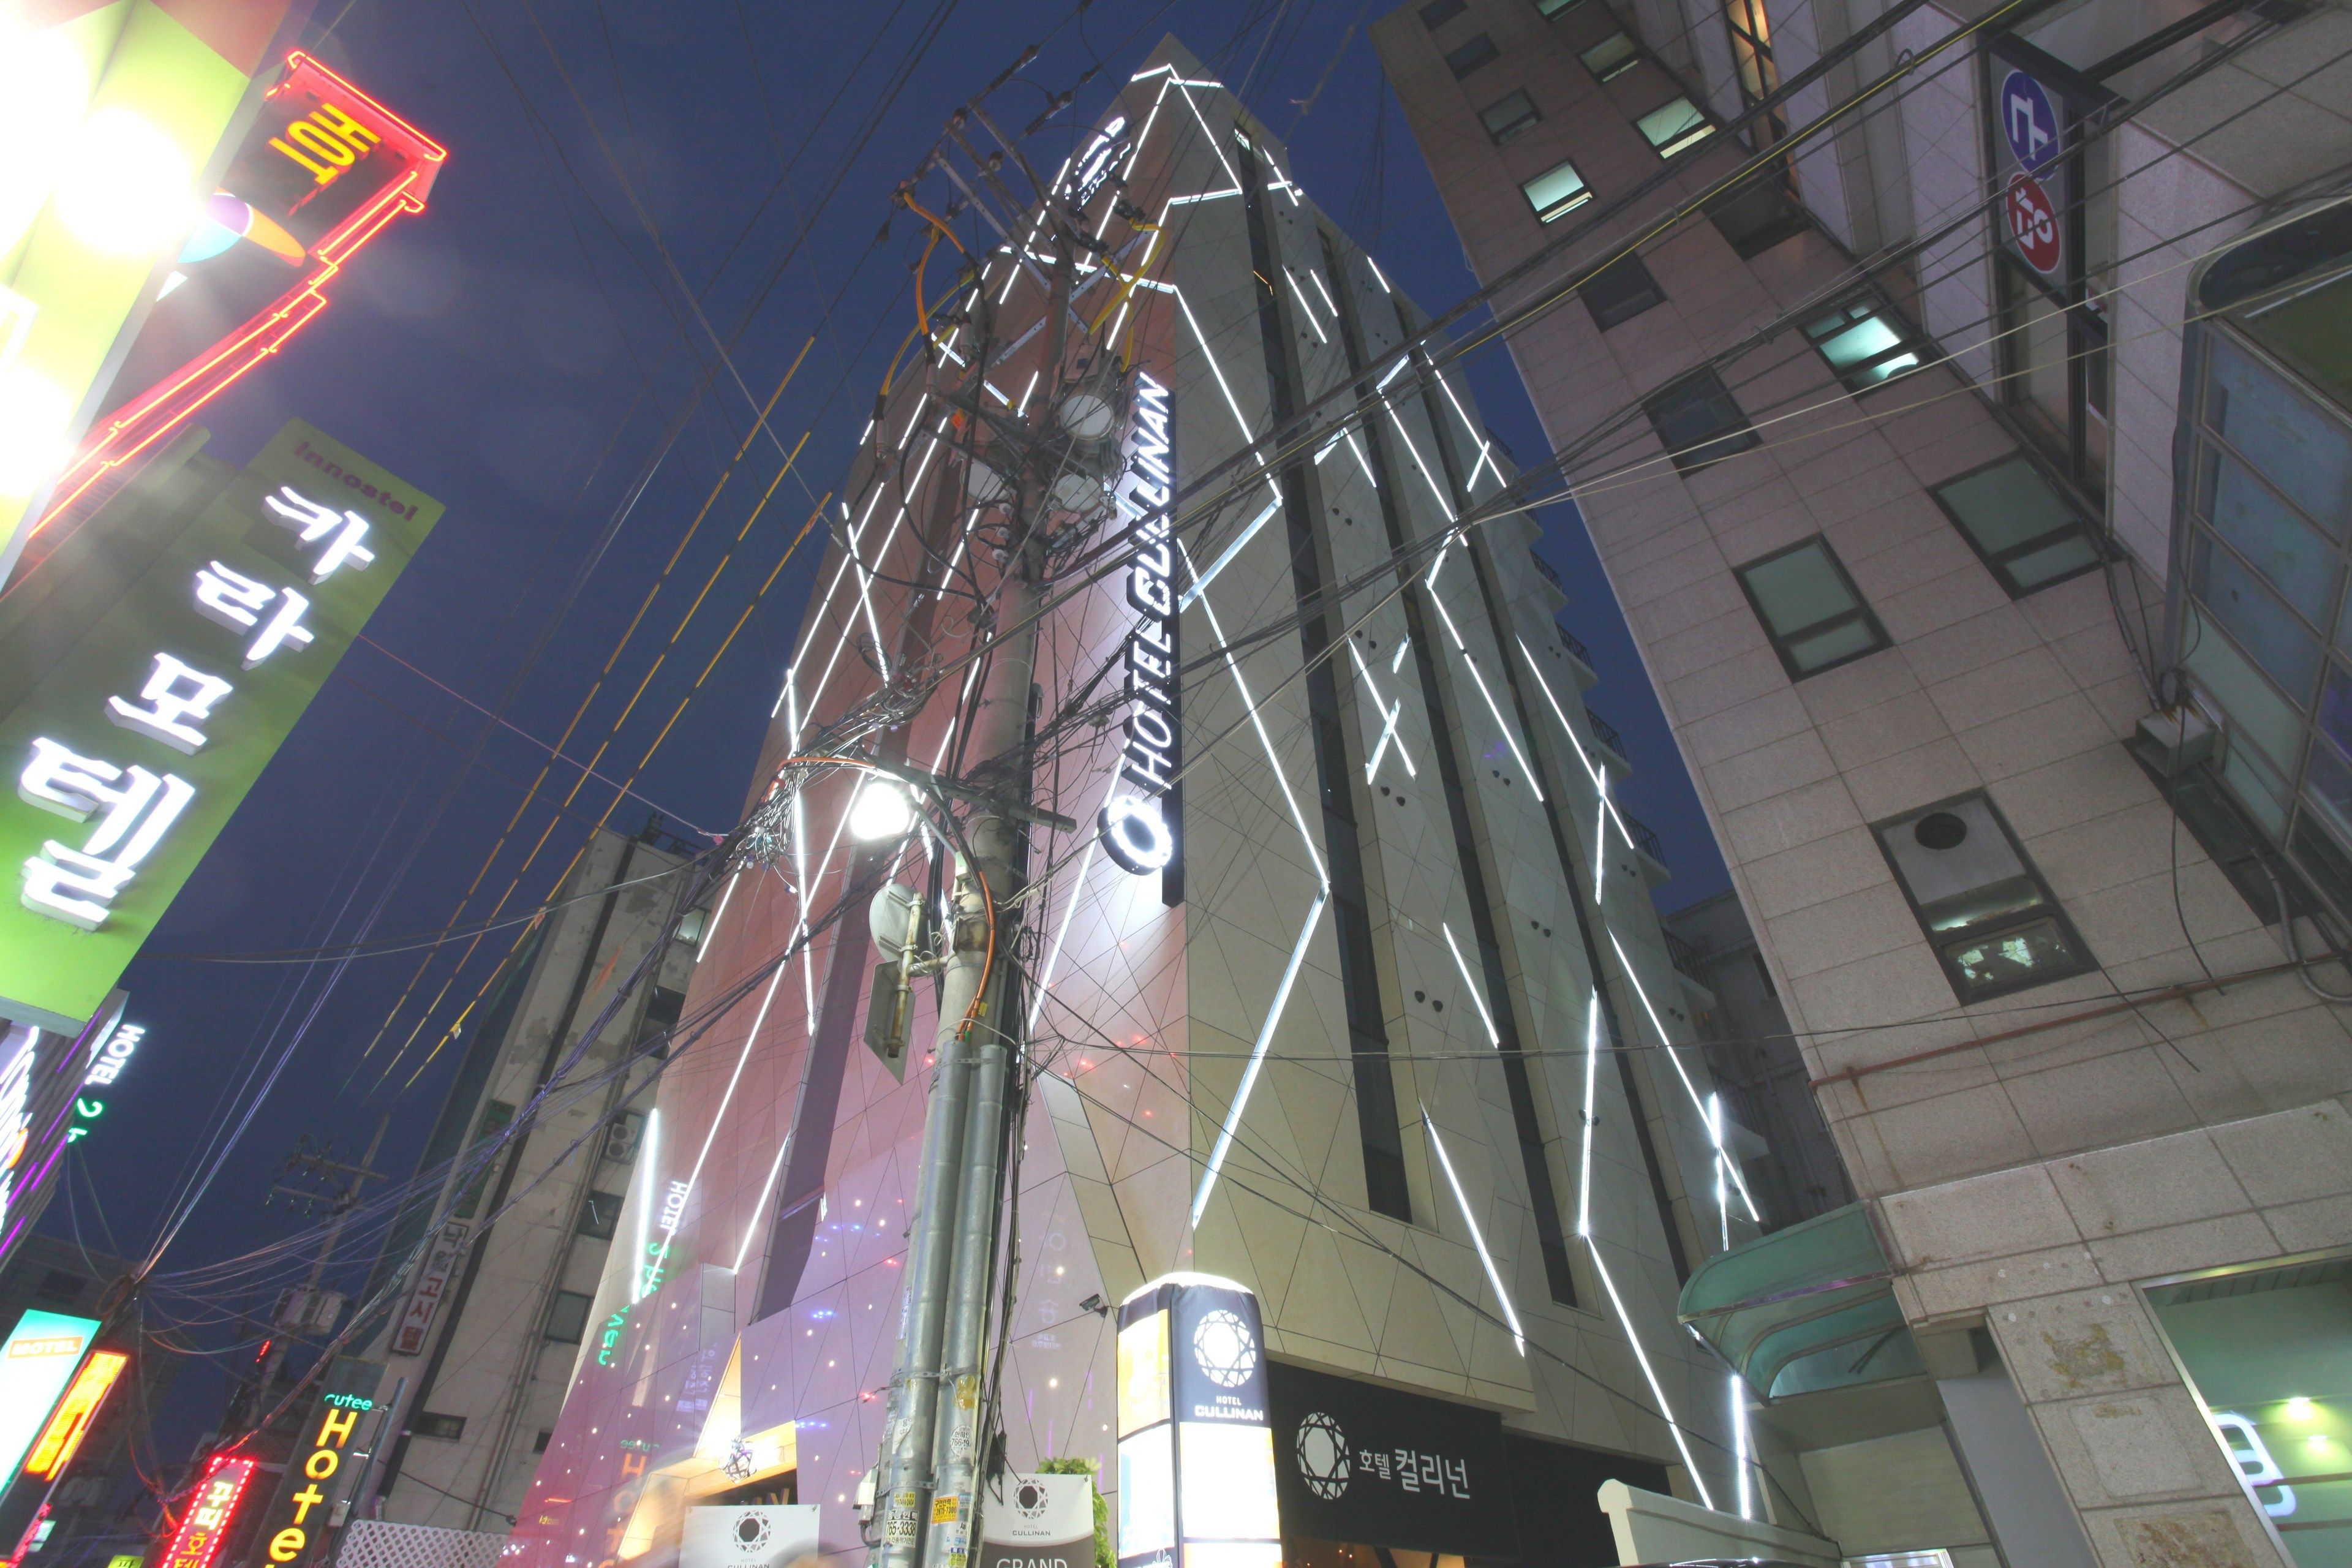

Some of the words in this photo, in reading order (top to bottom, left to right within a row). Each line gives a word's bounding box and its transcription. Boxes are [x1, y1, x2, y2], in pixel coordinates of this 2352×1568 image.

[293, 440, 418, 521] Innostel
[18, 486, 375, 932] 카라모텔
[85, 1023, 146, 1085] HOTEL
[12, 1340, 78, 1355] MOTEL
[1194, 1405, 1264, 1421] CULLINAN
[1216, 1395, 1242, 1406] HOTEL
[1359, 1449, 1391, 1480] 호텔
[1395, 1448, 1471, 1499] 컬리넌
